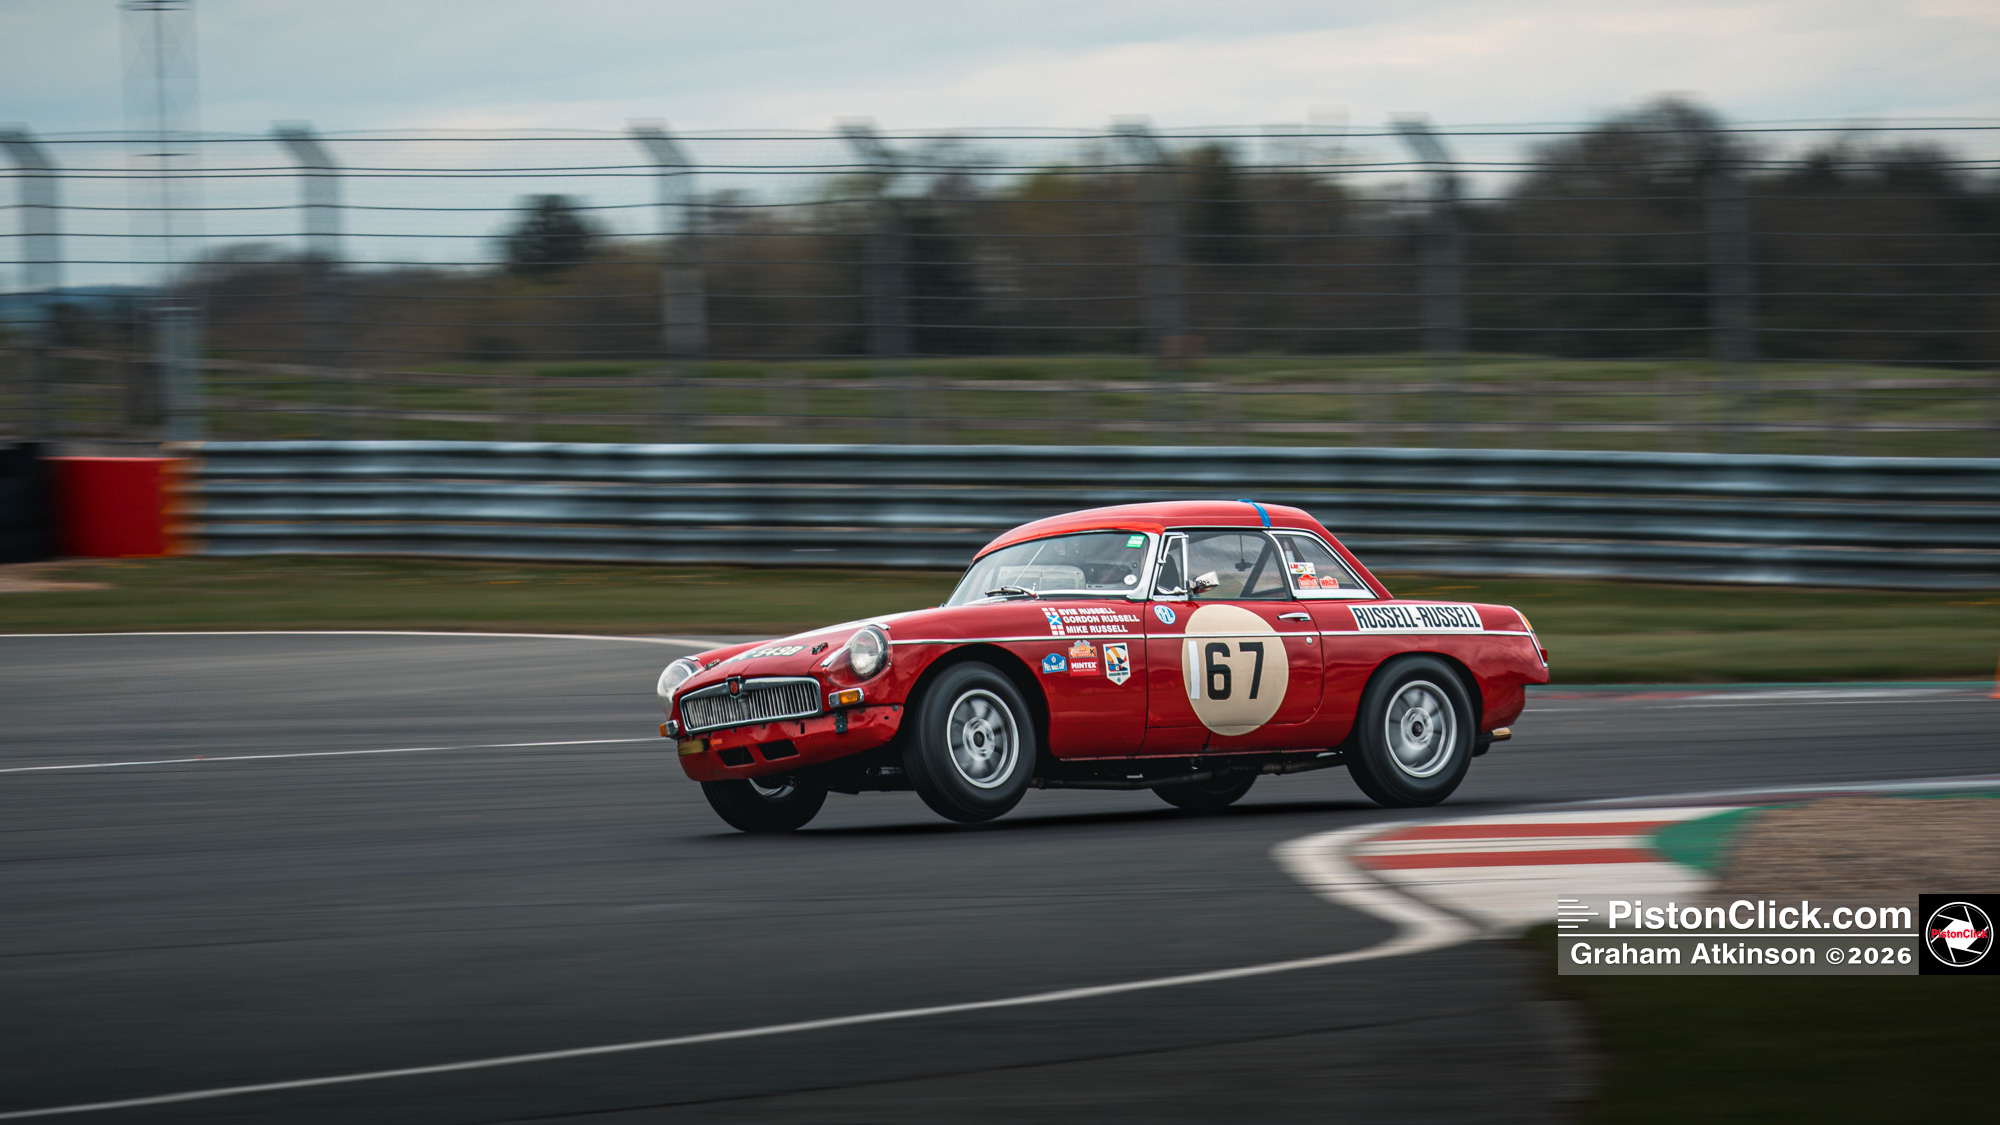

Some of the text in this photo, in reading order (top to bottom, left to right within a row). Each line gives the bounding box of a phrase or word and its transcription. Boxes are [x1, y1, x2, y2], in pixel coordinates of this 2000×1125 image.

[1057, 607, 1116, 616] EVIE RUSSELL
[1062, 614, 1140, 624] GORDON RUSSELL
[1352, 606, 1481, 629] RUSSELL-RUSSELL
[1065, 624, 1129, 634] MIKE RUSSELL
[1071, 661, 1097, 669] MINTEX
